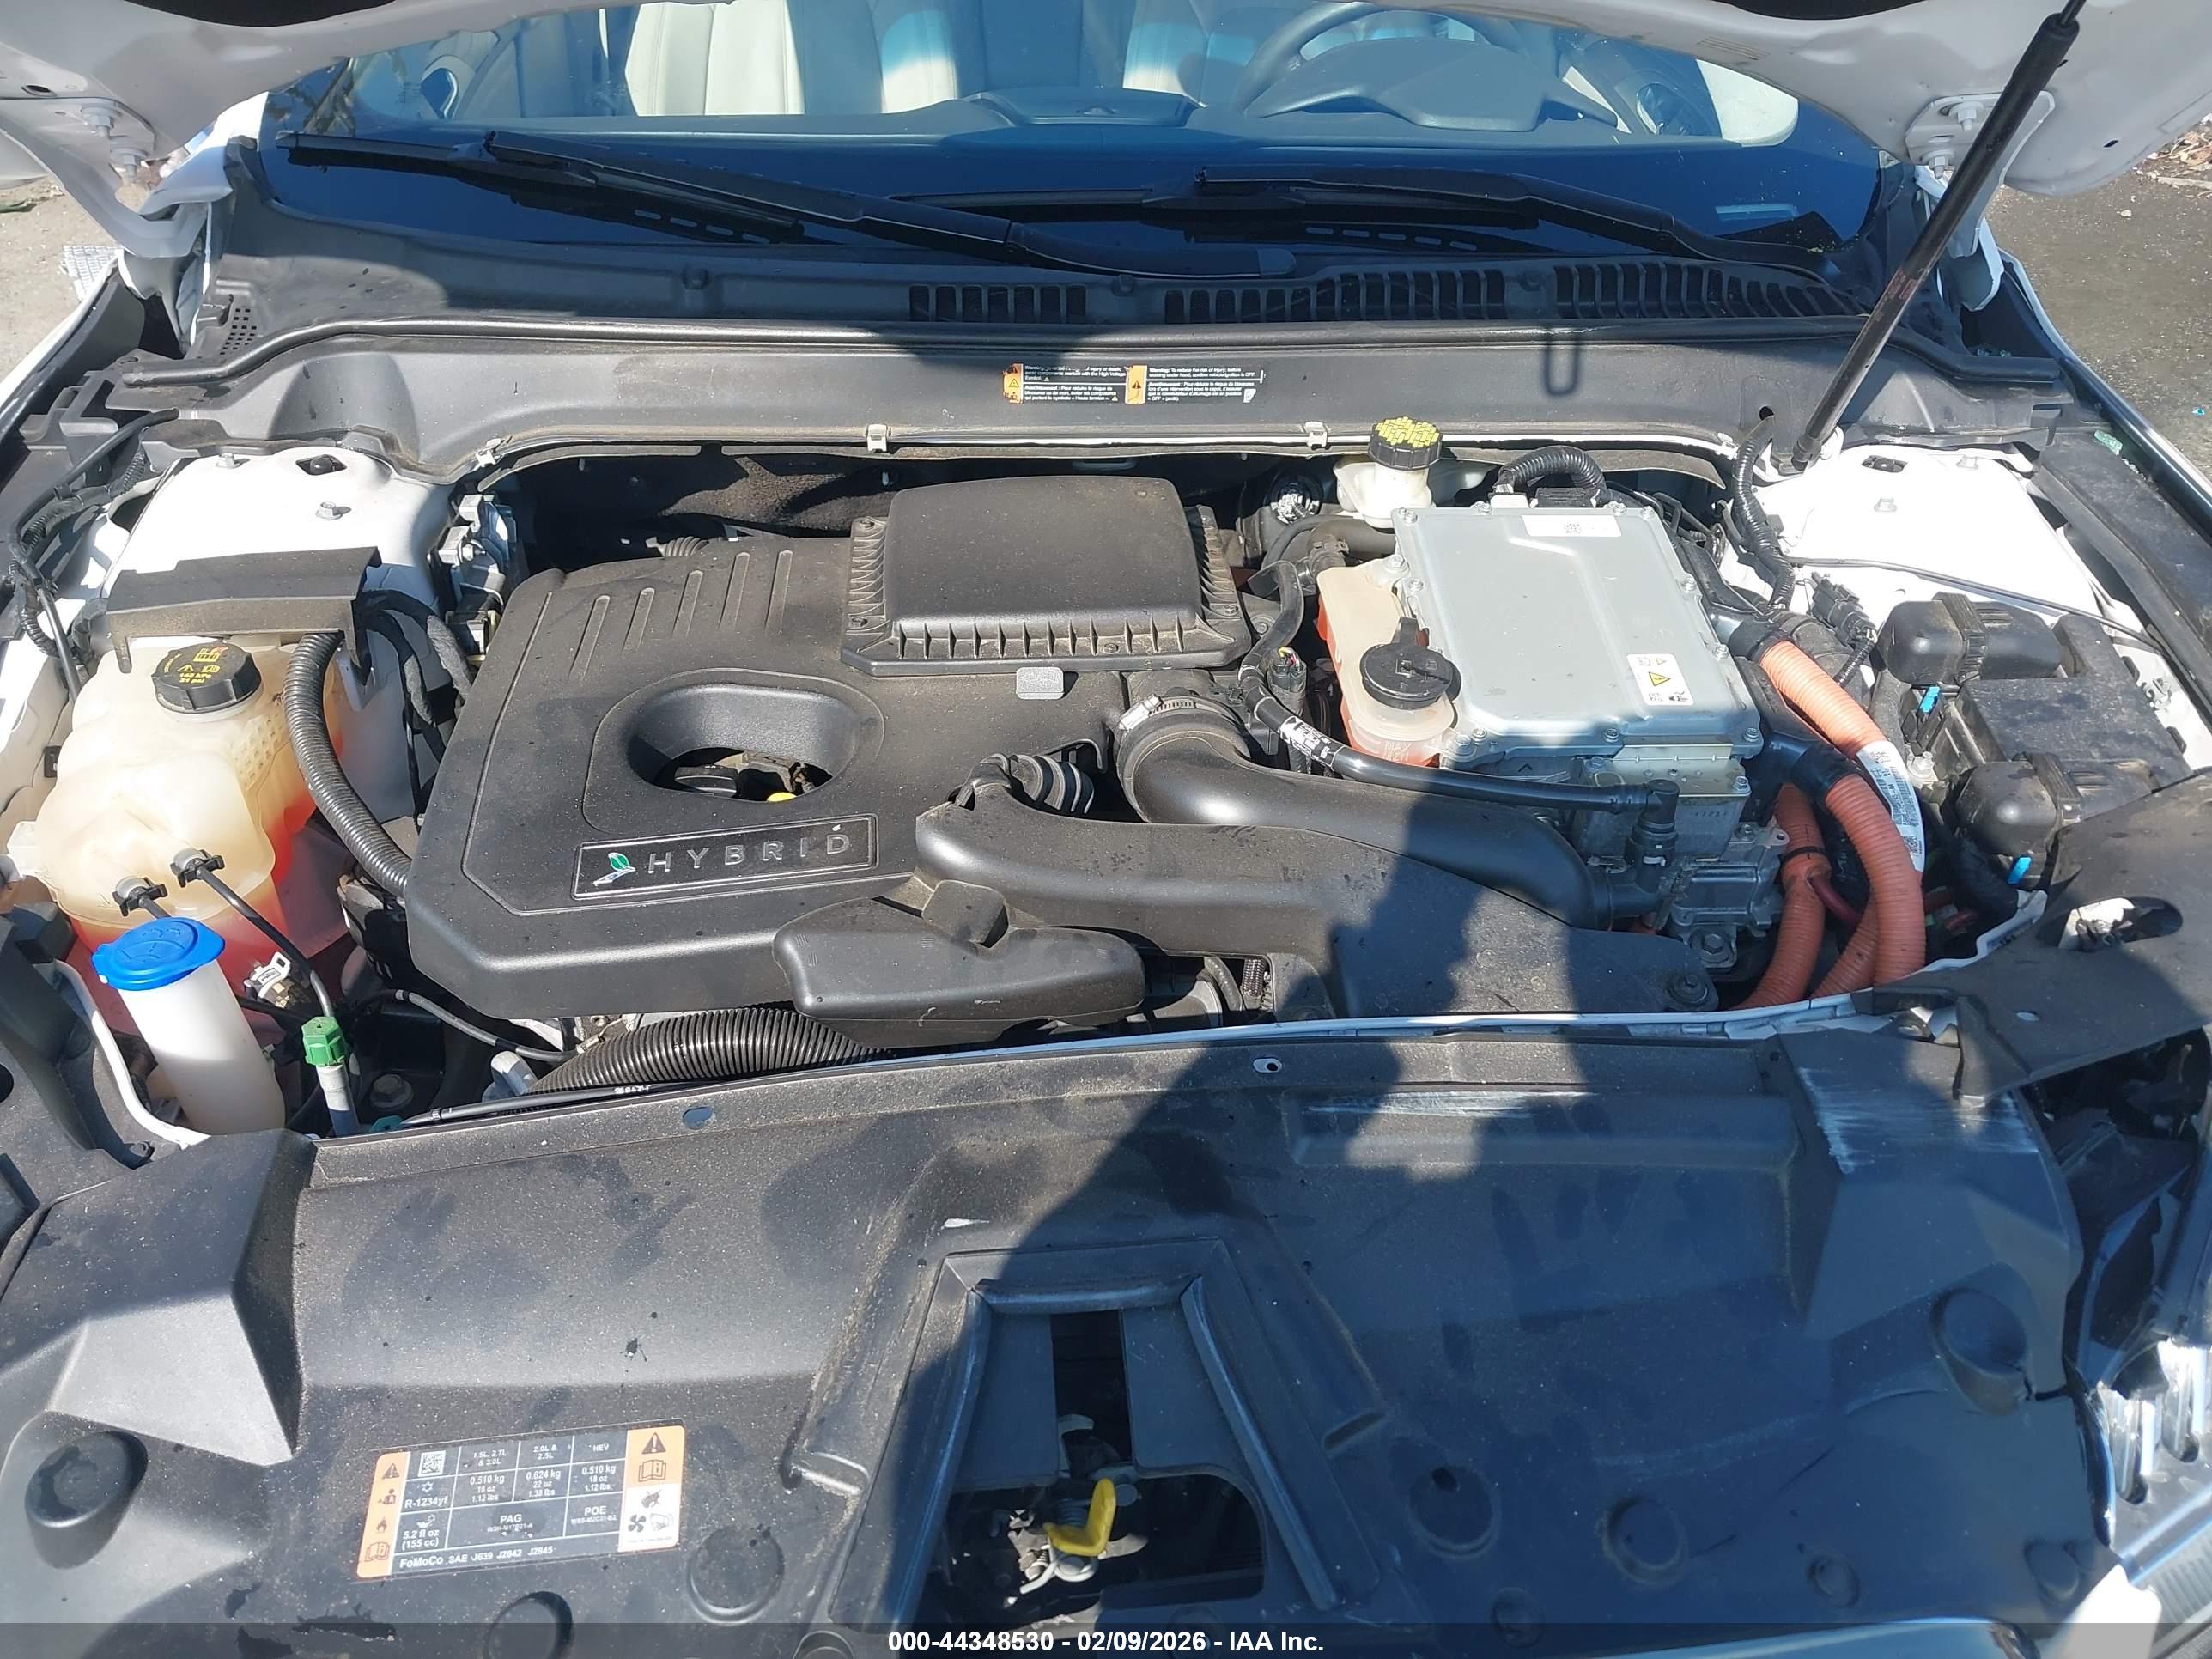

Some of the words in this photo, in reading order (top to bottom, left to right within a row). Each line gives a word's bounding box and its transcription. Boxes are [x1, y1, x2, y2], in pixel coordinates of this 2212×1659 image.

[647, 833, 851, 874] HYBRID
[592, 1443, 610, 1452] HEV
[526, 1470, 549, 1480] 0.624
[550, 1469, 562, 1480] kg
[581, 1465, 604, 1475] 0.510
[605, 1465, 617, 1474] kg
[470, 1475, 493, 1486] 0.510
[495, 1474, 505, 1485] kg
[404, 1496, 449, 1509] R-1234yf
[584, 1505, 607, 1516] POE
[500, 1514, 523, 1524] PAG
[403, 1530, 418, 1540] 5.2
[419, 1528, 426, 1537] fl
[402, 1540, 422, 1551] (155
[423, 1538, 440, 1547] cc)
[399, 1556, 444, 1569] FoMoCo
[448, 1553, 468, 1564] SAE
[471, 1552, 493, 1562] J639
[496, 1549, 523, 1559] J2842
[527, 1546, 553, 1557] J2845
